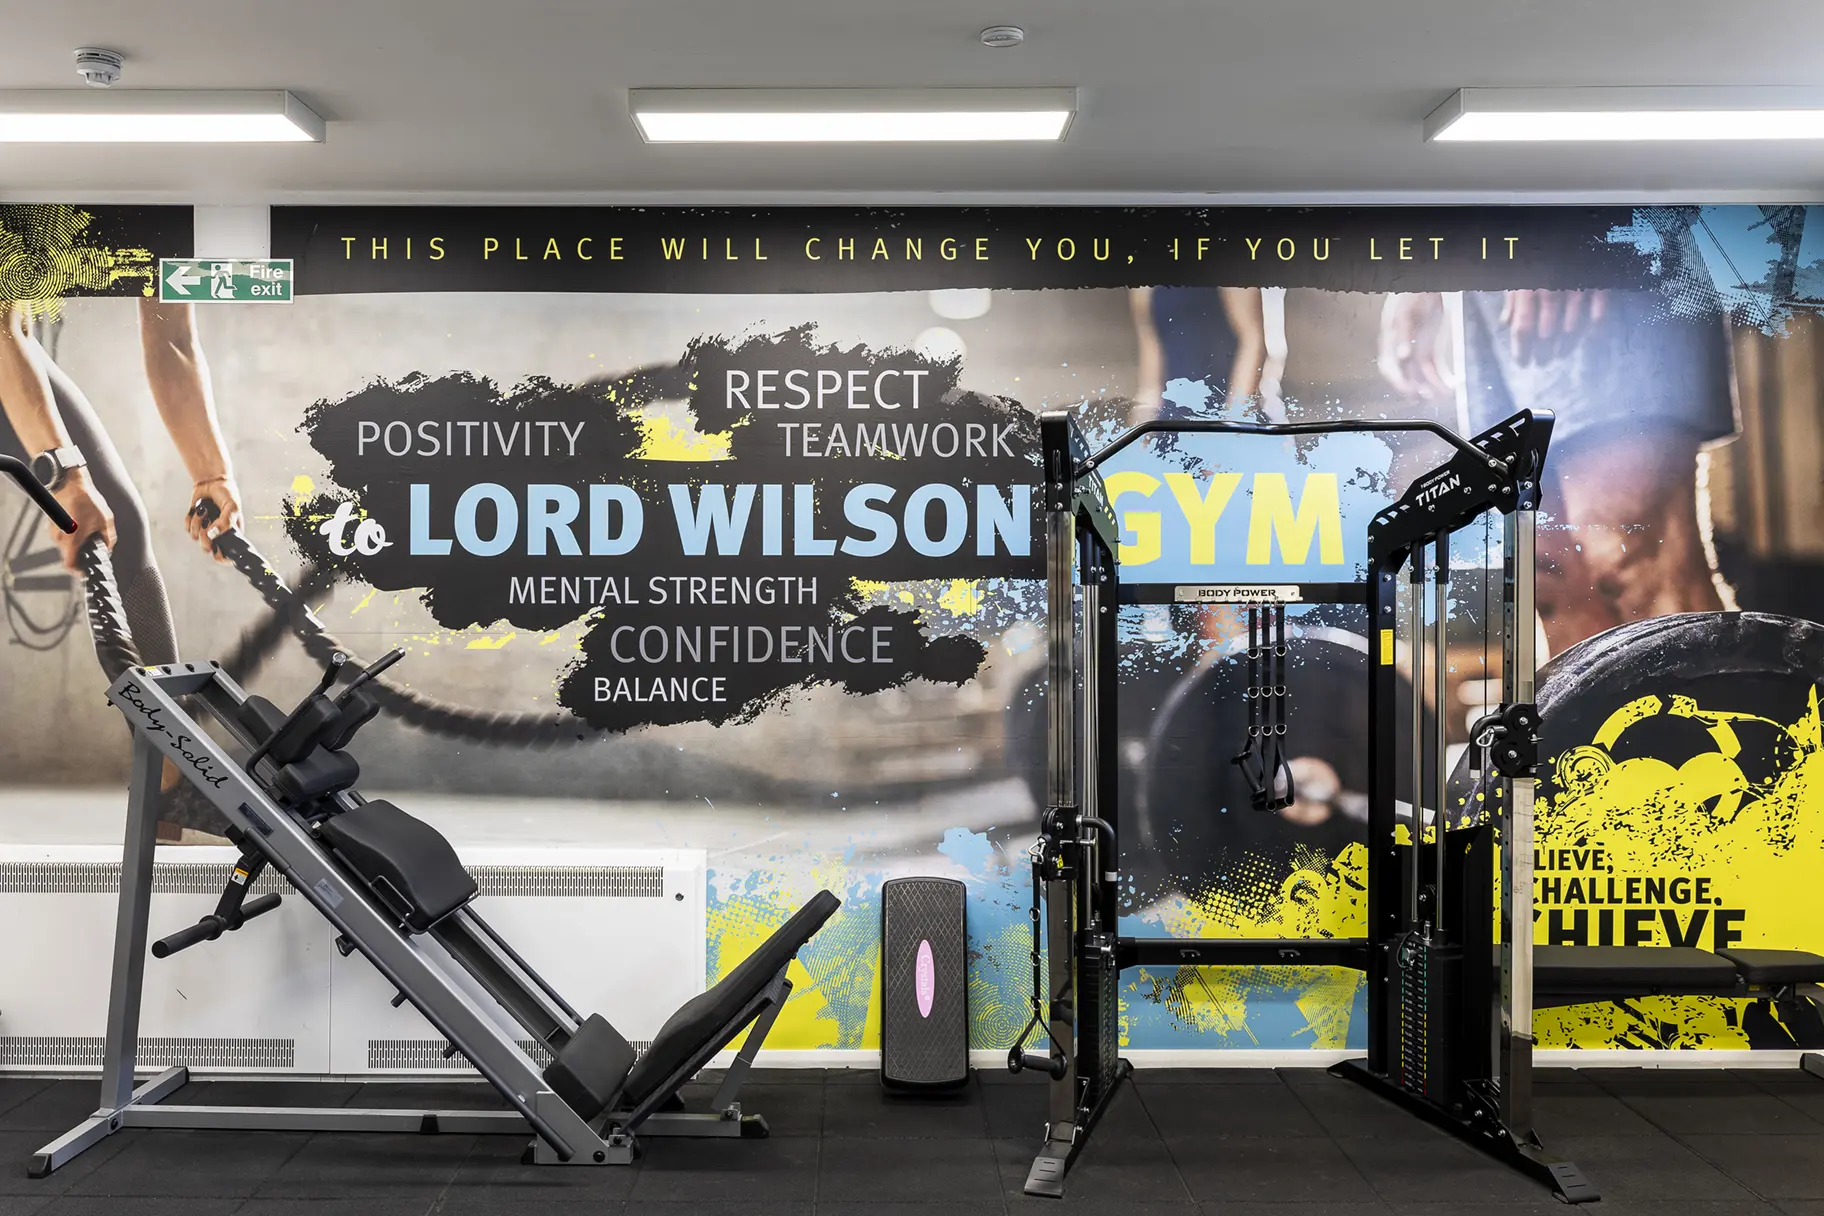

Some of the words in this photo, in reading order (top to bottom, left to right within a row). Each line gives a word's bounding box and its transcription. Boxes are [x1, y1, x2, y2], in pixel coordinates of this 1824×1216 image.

[342, 237, 445, 260] THIS
[484, 237, 625, 260] PLACE
[661, 237, 767, 260] WILL
[805, 237, 989, 260] CHANGE
[1026, 237, 1135, 263] YOU,
[1172, 237, 1210, 260] IF
[1246, 237, 1330, 260] YOU
[1370, 237, 1444, 260] LET
[1482, 237, 1521, 260] IT
[249, 264, 284, 279] Fire
[250, 281, 283, 296] exit
[726, 369, 929, 410] RESPECT
[357, 420, 585, 457] POSITIVITY
[777, 421, 1016, 459] TEAMWORK
[1415, 474, 1461, 507] TITAN
[319, 501, 394, 557] to
[409, 483, 643, 557] LORD
[668, 483, 1032, 557] WILSON
[1104, 471, 1345, 566] GYM
[509, 576, 639, 605] MENTAL
[648, 576, 818, 605] STRENGTH
[1198, 589, 1231, 597] BODY
[1233, 588, 1277, 598] POWER
[610, 625, 894, 664] CONFIDENCE
[594, 677, 727, 702] BALANCE
[118, 680, 229, 789] Body-Solid
[1533, 849, 1614, 874] LIEVE,
